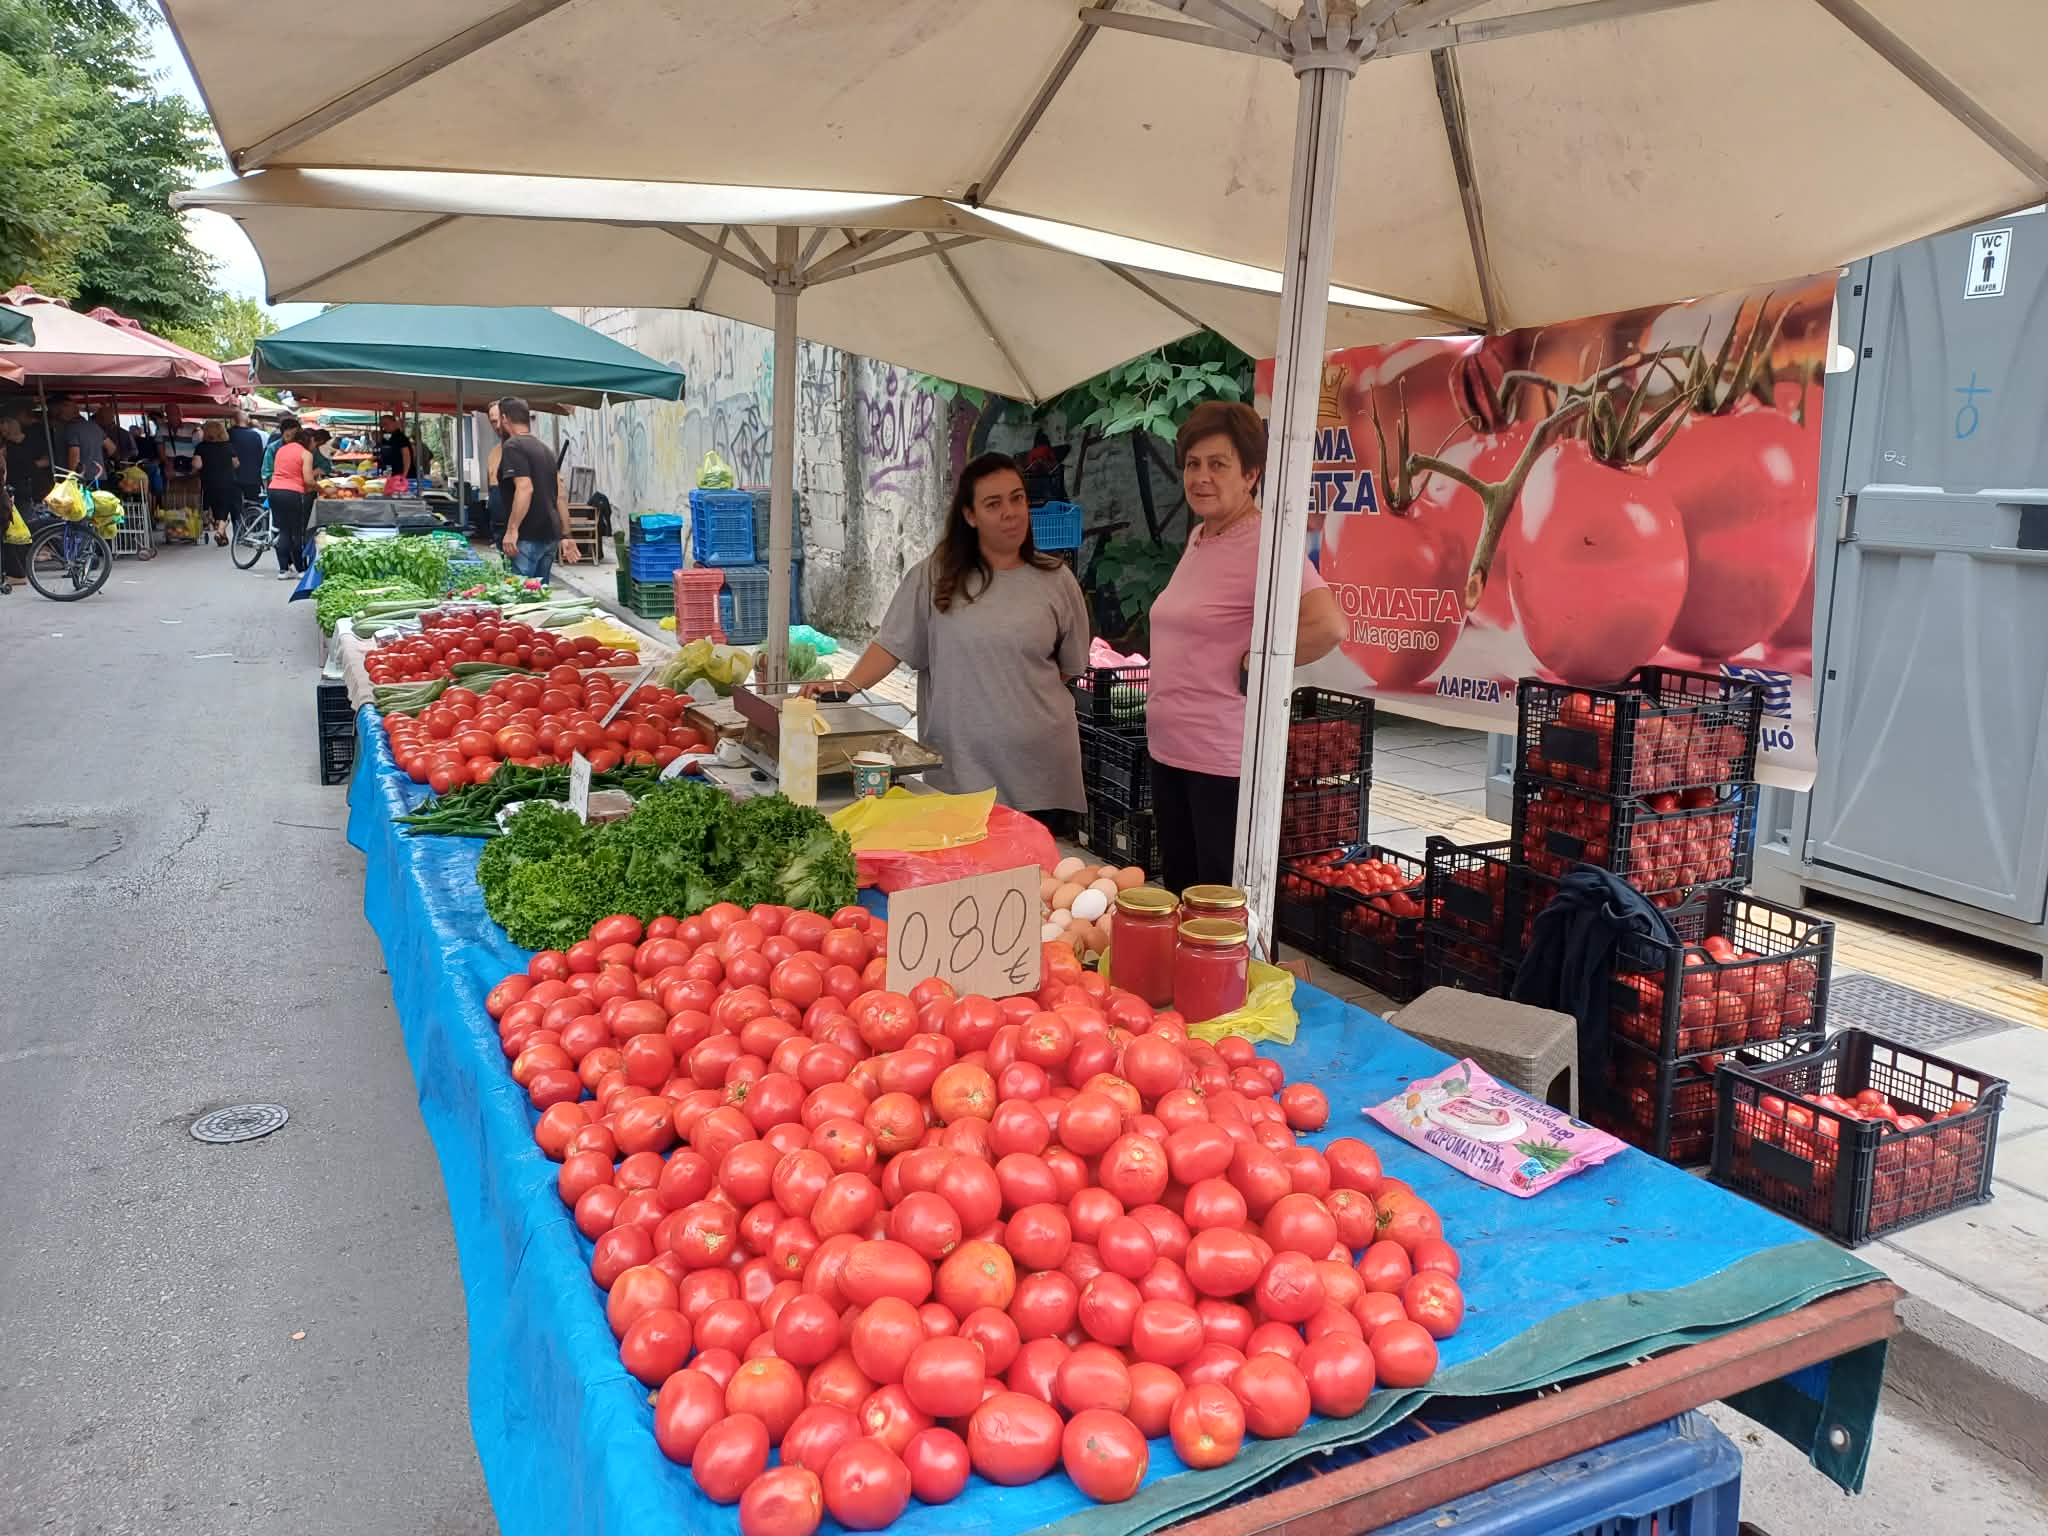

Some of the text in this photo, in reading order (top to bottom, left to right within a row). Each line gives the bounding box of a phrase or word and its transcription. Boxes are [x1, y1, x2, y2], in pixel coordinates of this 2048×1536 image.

[1981, 235, 2003, 249] WC
[1313, 427, 1355, 462] ΜΑ
[1308, 471, 1379, 514] ΤΣΑ
[1353, 619, 1440, 653] Margano
[1436, 674, 1501, 704] ΛΑΡΙΣΑ
[1760, 723, 1796, 752] μό
[898, 888, 1031, 985] 0,80 €
